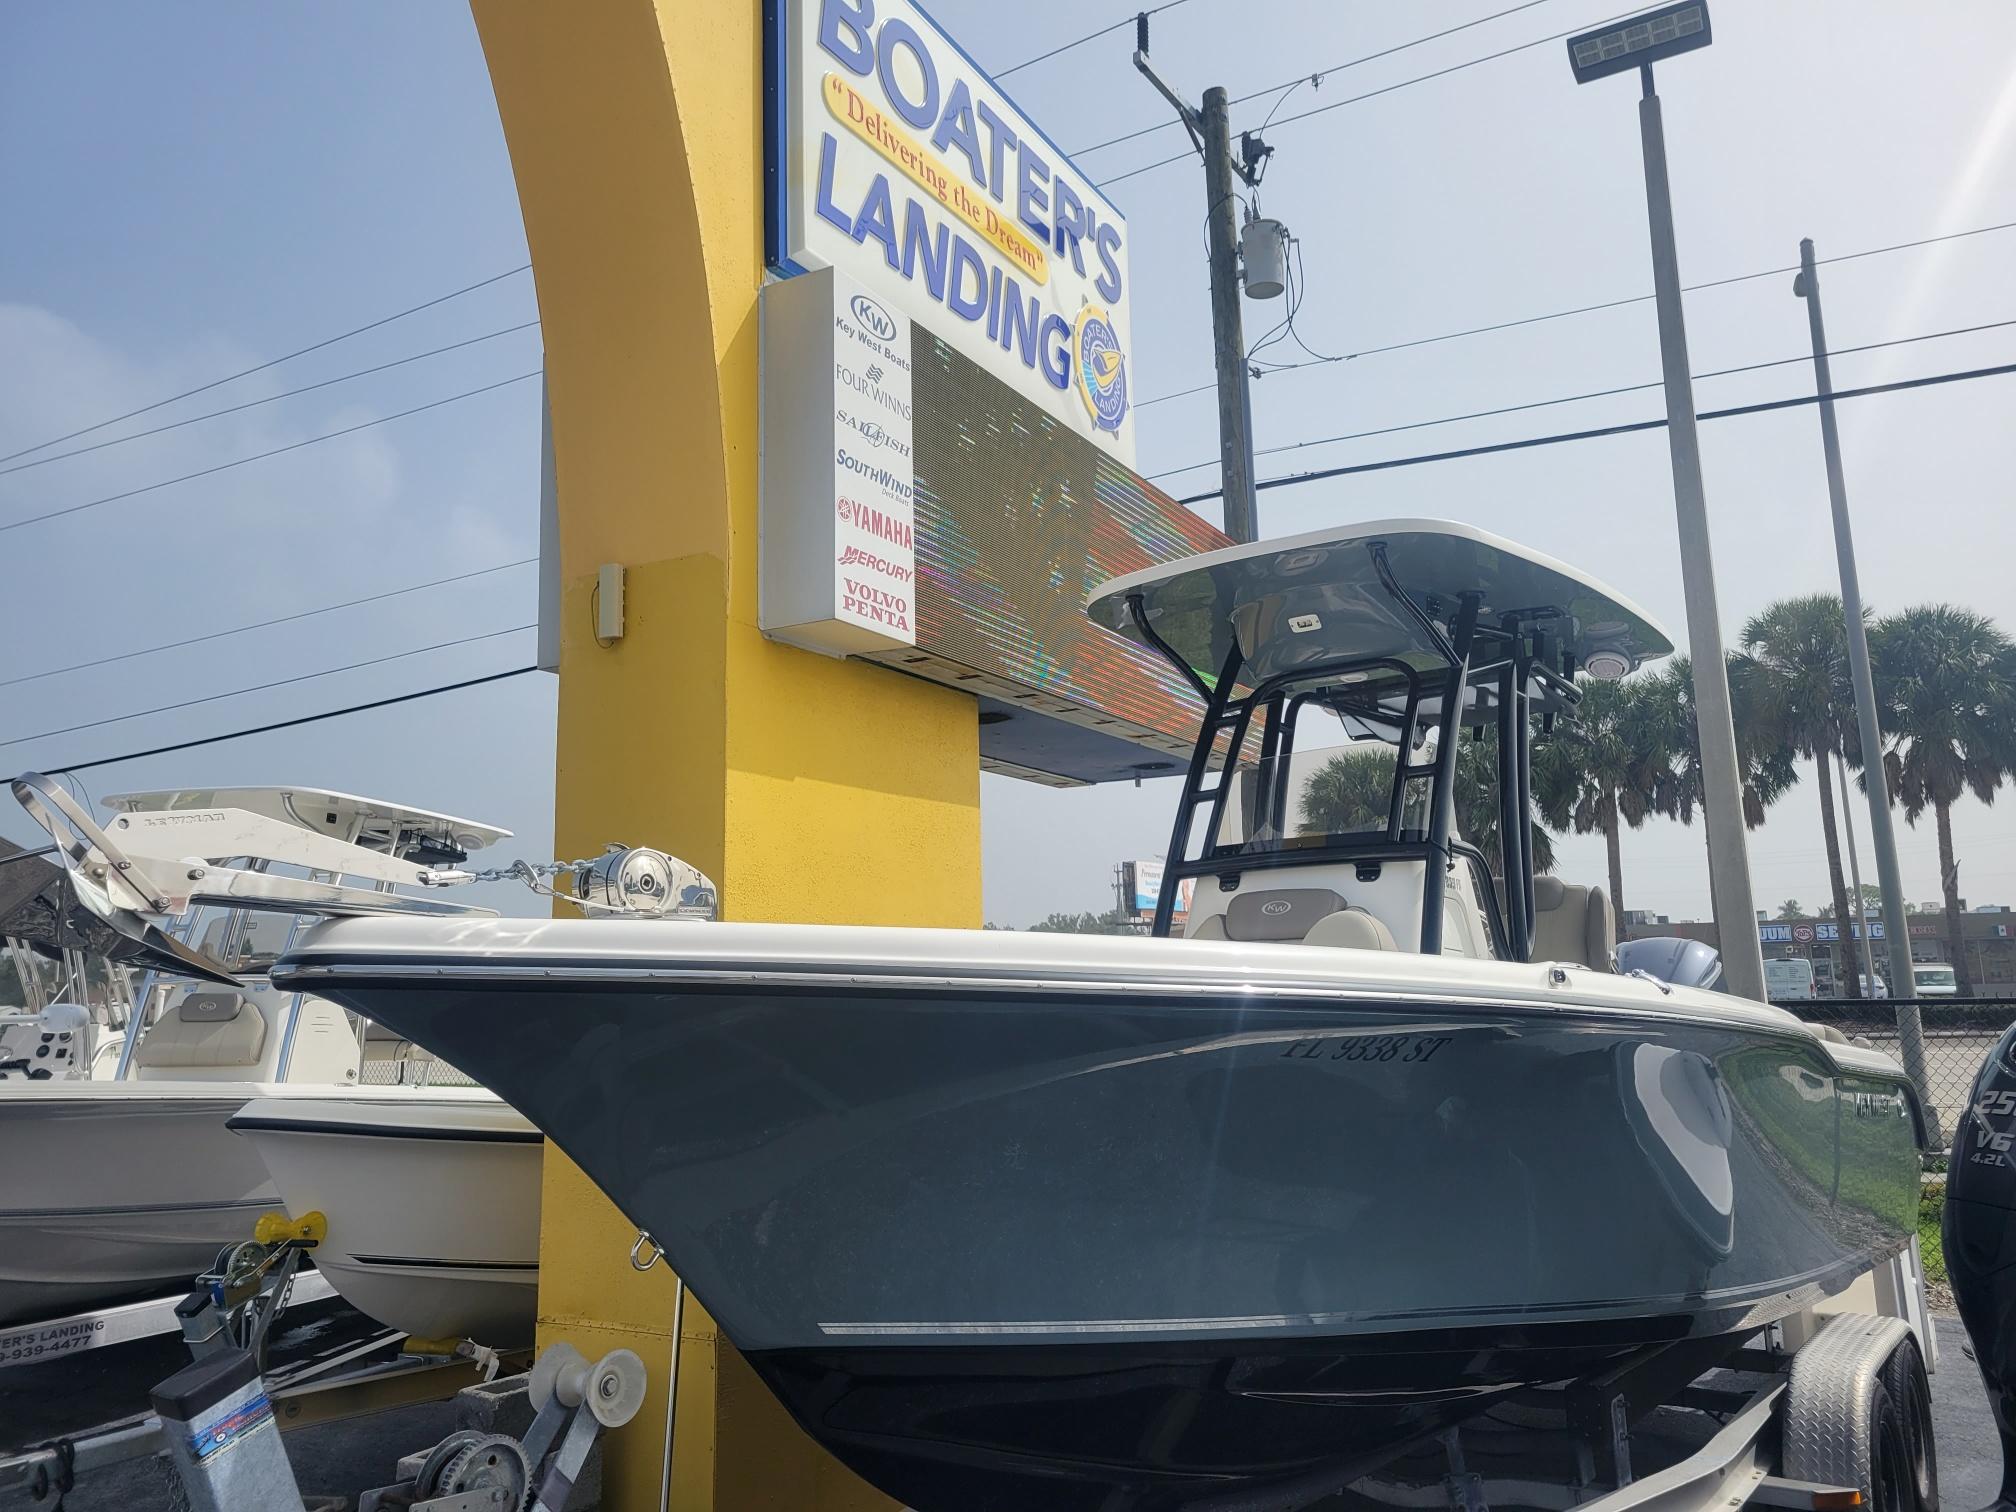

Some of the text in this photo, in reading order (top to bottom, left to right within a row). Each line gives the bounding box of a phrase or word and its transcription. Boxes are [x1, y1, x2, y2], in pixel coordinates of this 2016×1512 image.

[818, 0, 1123, 304] BOATER'S
[953, 185, 981, 224] the
[816, 132, 1072, 391] LANDING
[859, 300, 889, 337] KW
[835, 316, 911, 372] Key West Boats
[1083, 323, 1113, 361] BOATER'S
[836, 363, 912, 422] FOUR WINNS
[1094, 375, 1121, 413] LANDING
[836, 409, 911, 457] SAILFISH
[851, 500, 913, 550] YAMAHA
[838, 545, 914, 583] MERCURY
[842, 594, 909, 632] PENTA
[843, 577, 907, 614] VOLVO
[1401, 1037, 1453, 1063] ST
[1981, 1090, 2016, 1115] 25
[1970, 1152, 2007, 1167] 4.2L
[1976, 1130, 2016, 1152] V6
[40, 1320, 105, 1342] LANDING
